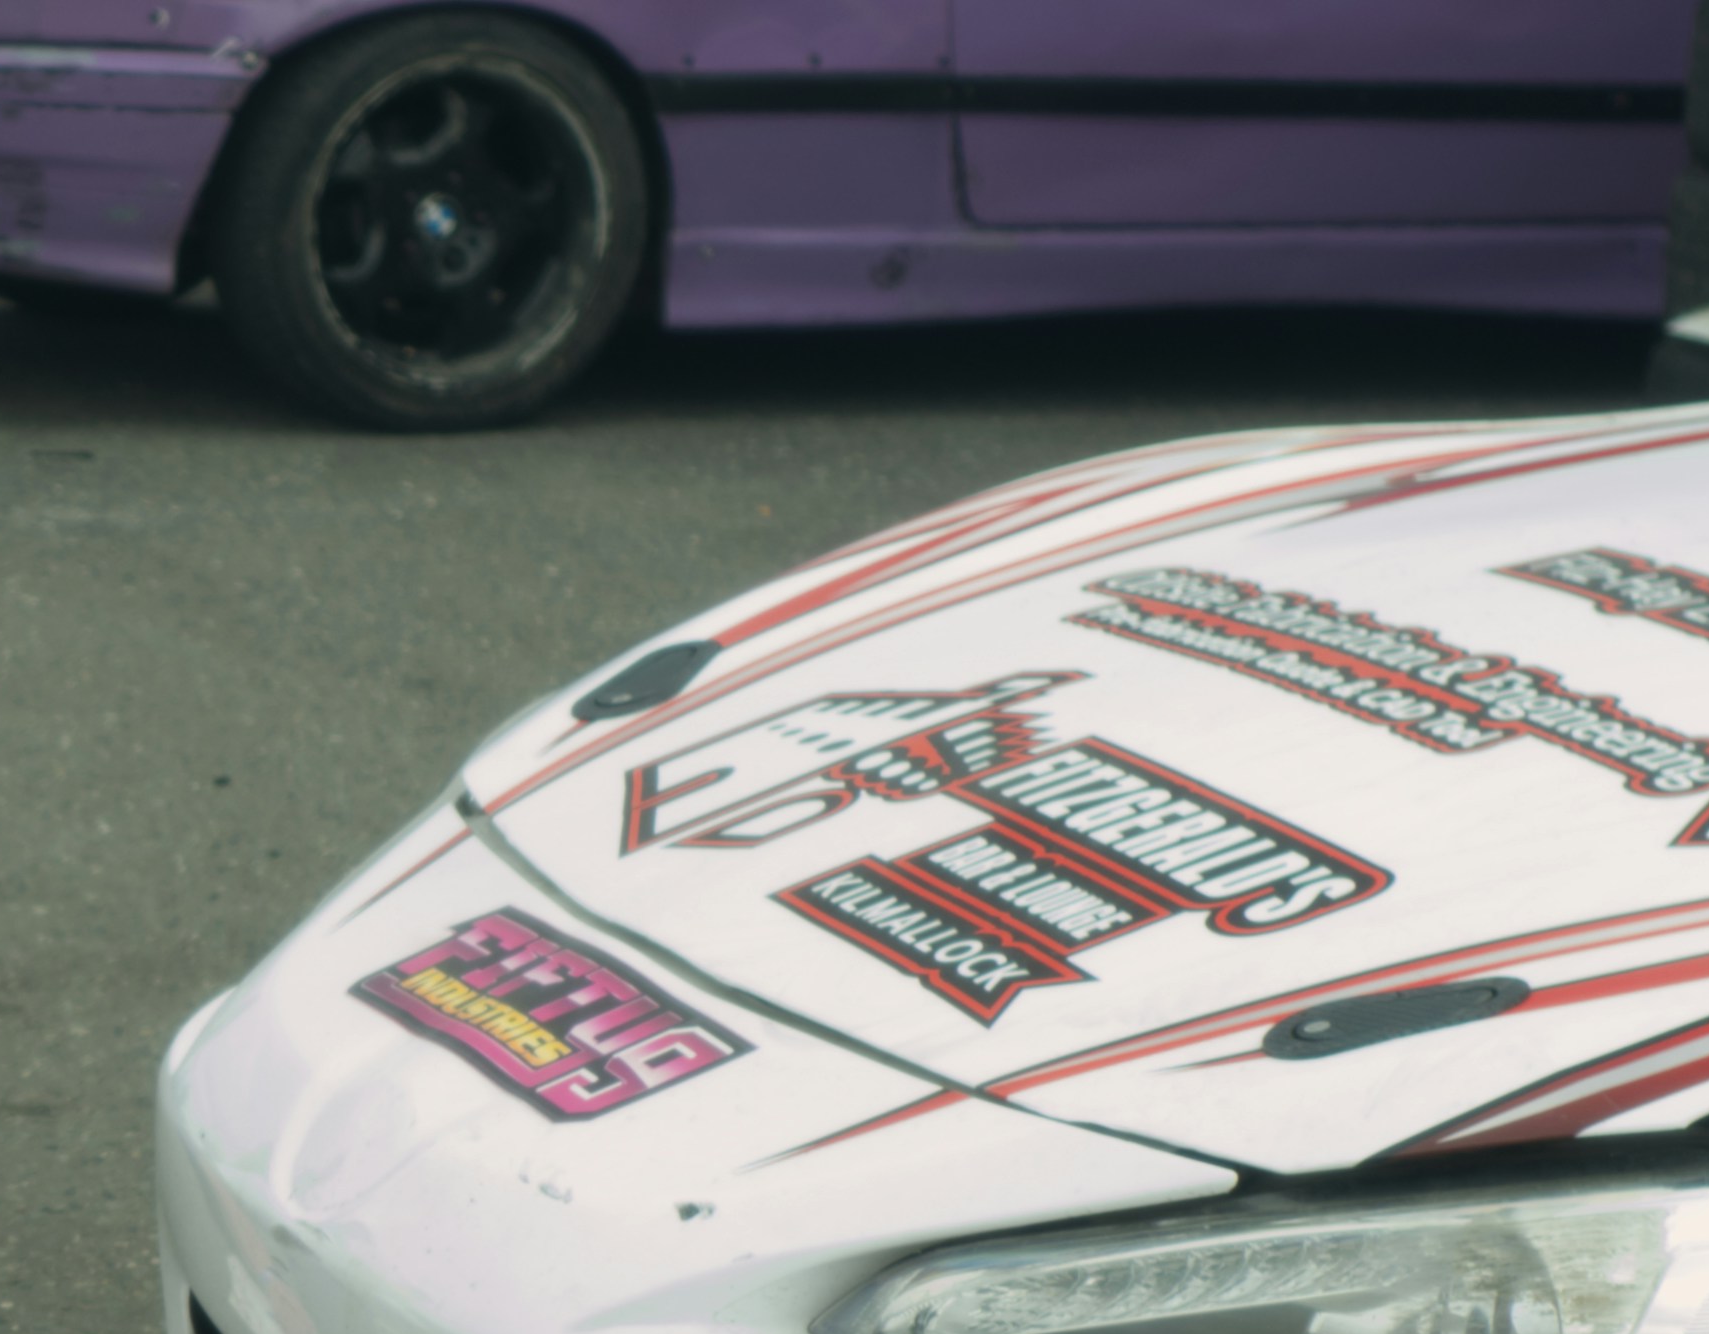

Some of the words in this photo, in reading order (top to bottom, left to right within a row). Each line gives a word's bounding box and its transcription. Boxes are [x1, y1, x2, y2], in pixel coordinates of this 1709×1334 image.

[1418, 657, 1489, 686] &
[1329, 678, 1377, 699] &
[1356, 688, 1437, 721] CAD
[1418, 710, 1504, 748] Tool
[927, 835, 1016, 881] BAR
[979, 748, 1357, 924] FITZGERALD'S
[978, 861, 1037, 891] &
[999, 873, 1134, 940] LOUNGE
[811, 871, 1030, 991] KILMALLOCK
[399, 967, 572, 1067] INDUSTRIES
